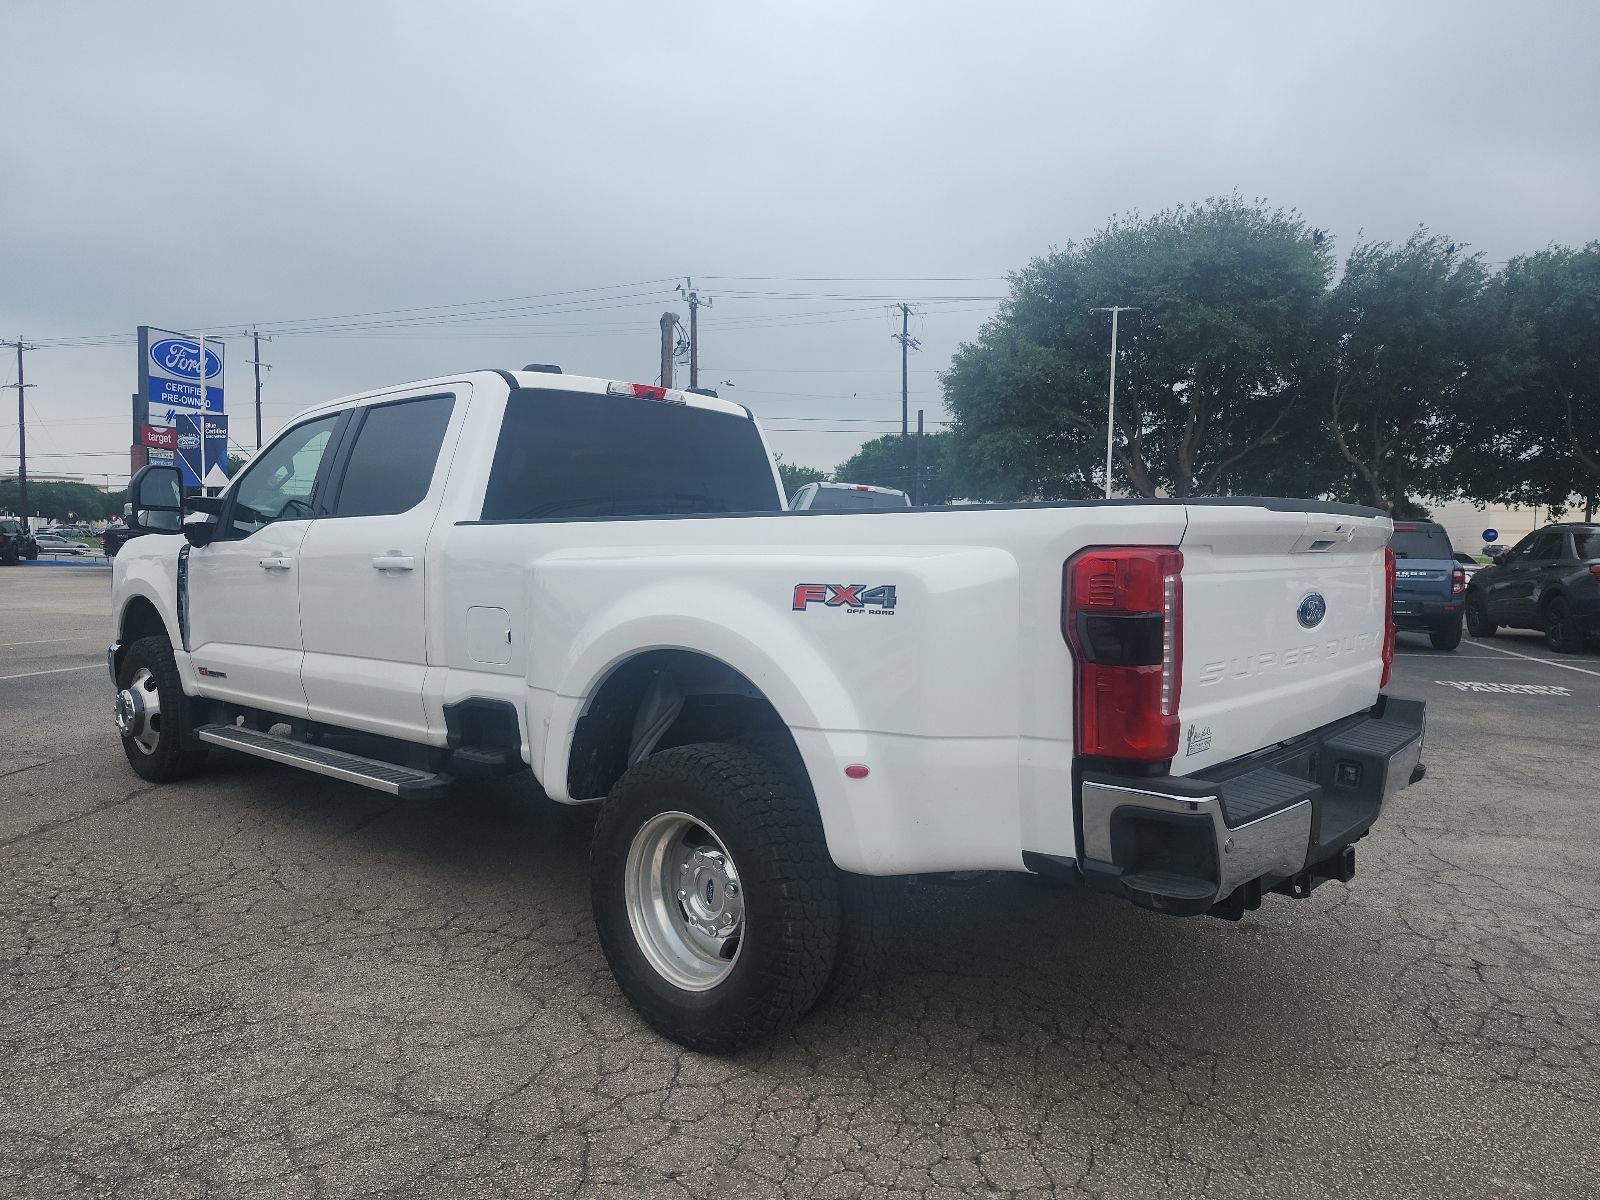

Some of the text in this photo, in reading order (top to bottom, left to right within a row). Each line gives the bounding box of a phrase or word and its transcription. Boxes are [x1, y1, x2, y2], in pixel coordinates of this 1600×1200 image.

[161, 392, 211, 408] PRE-OWND
[148, 431, 172, 444] target
[792, 584, 897, 611] FX4
[1199, 631, 1380, 687] SUPER DUTY
